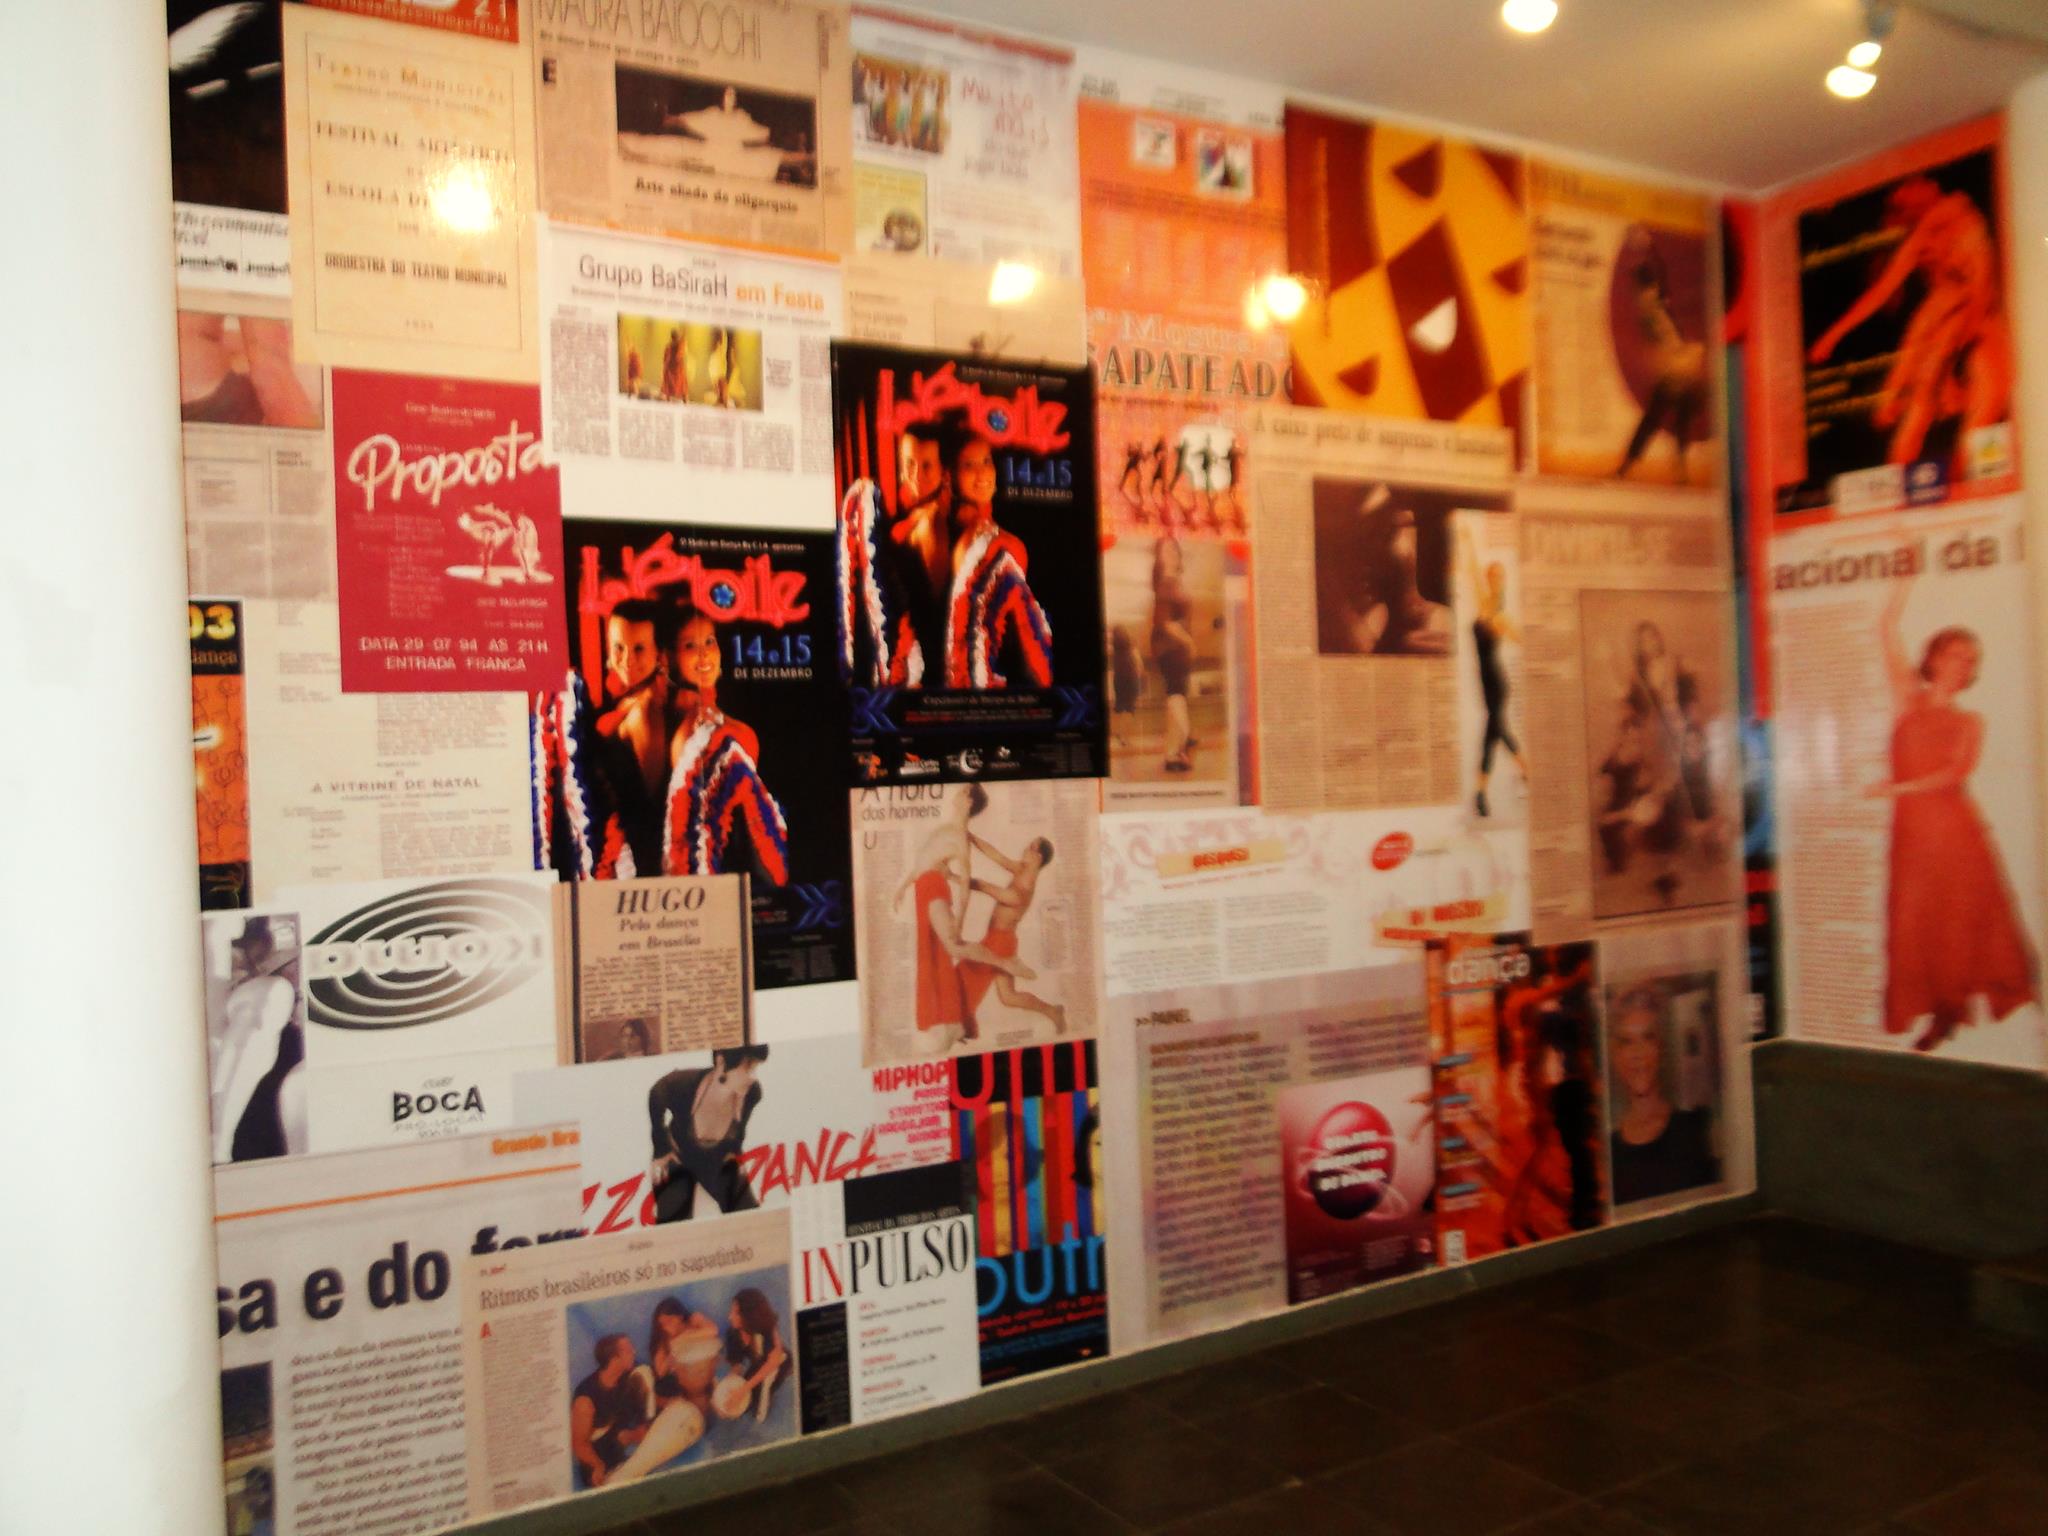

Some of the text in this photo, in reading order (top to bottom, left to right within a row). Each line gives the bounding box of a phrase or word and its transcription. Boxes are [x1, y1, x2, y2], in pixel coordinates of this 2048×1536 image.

[579, 253, 643, 289] Grupo
[651, 263, 729, 298] BaSiraH
[735, 284, 767, 304] em
[348, 420, 560, 512] Proposta
[359, 636, 399, 654] DATA
[732, 634, 763, 665] 14
[781, 633, 812, 665] 15
[384, 656, 456, 672] ENTRADA
[752, 667, 813, 680] DEZEMBRO
[331, 780, 396, 793] VITRINE
[404, 778, 426, 791] DE
[432, 776, 482, 789] NATAL
[888, 801, 942, 819] homens
[616, 886, 706, 915] HUGO
[392, 1084, 486, 1123] BOCA
[303, 1266, 345, 1321] e
[367, 1240, 452, 1310] do
[480, 1285, 540, 1312] Ritmos
[542, 1265, 631, 1299] brasileiros
[656, 1261, 677, 1279] no
